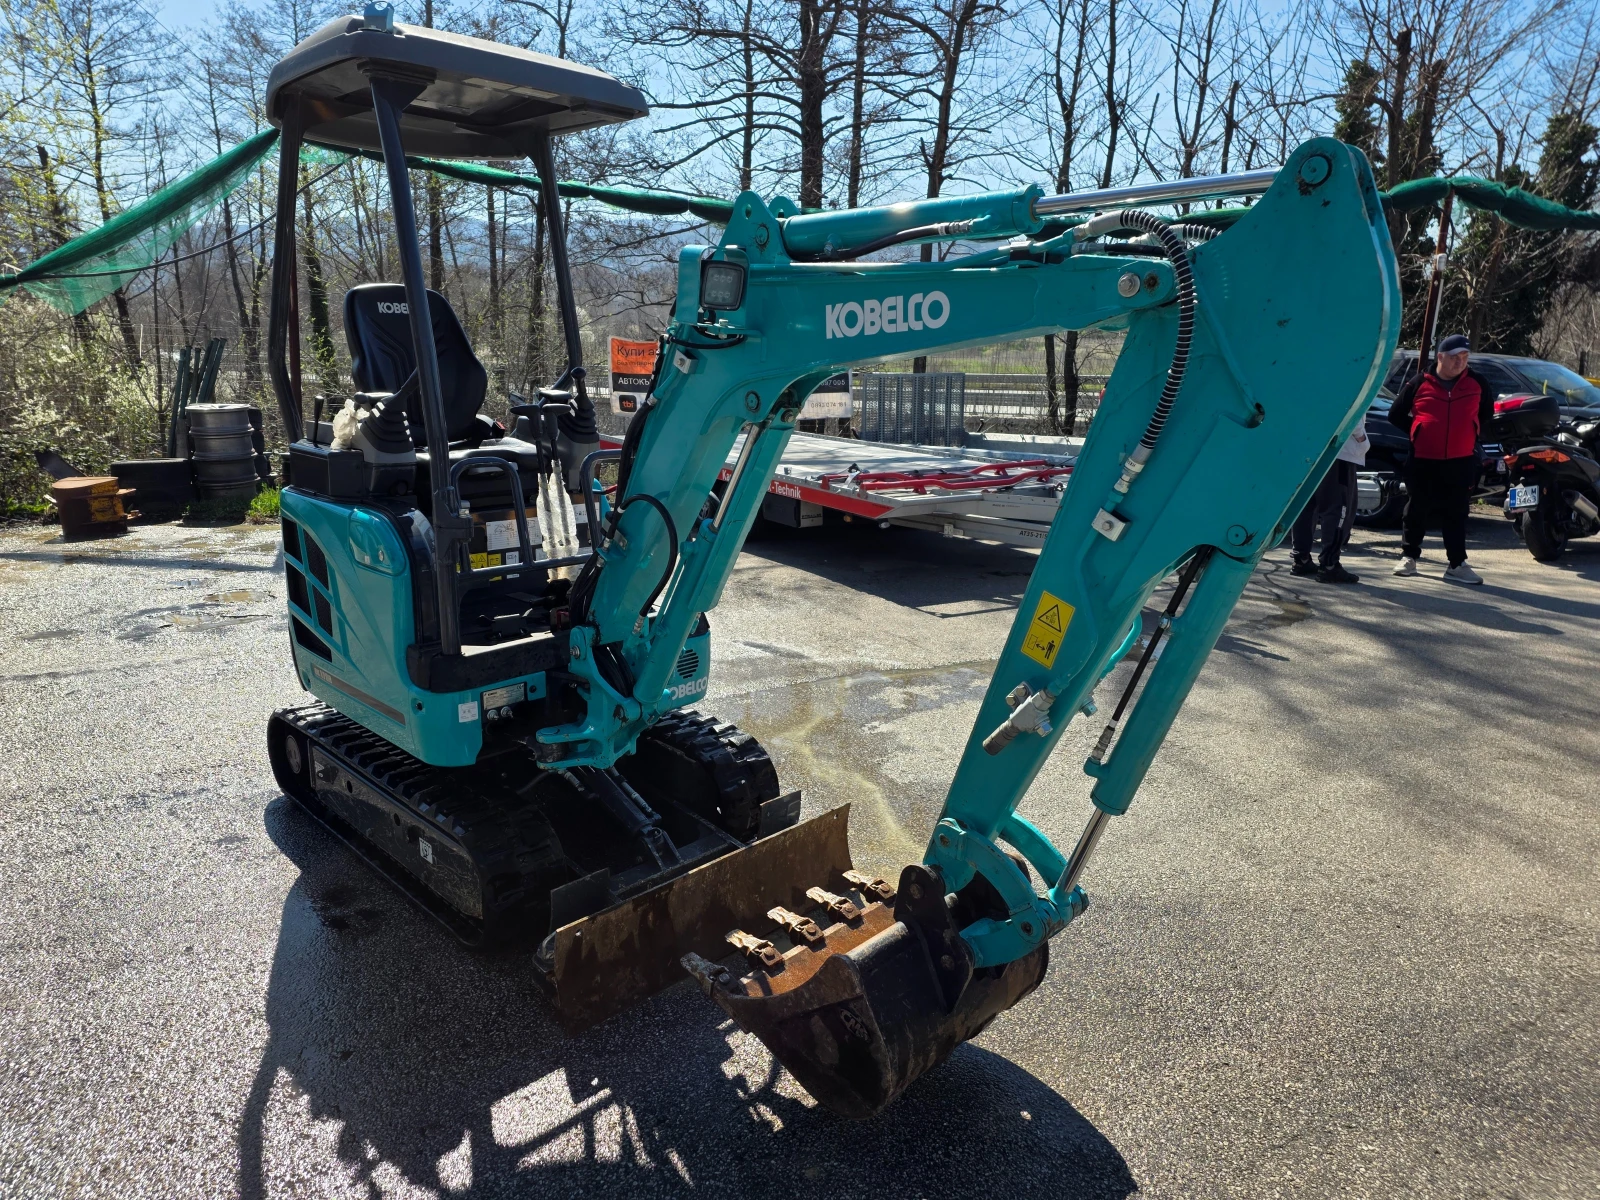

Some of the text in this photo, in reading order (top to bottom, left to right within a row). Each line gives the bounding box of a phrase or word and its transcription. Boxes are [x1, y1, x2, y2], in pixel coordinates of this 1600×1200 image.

[825, 290, 950, 339] KOBELCO
[617, 345, 645, 358] Купи
[618, 377, 651, 386] АВТОКЪ
[622, 400, 635, 408] tbi
[1531, 487, 1537, 495] M
[667, 676, 708, 701] OBELCO
